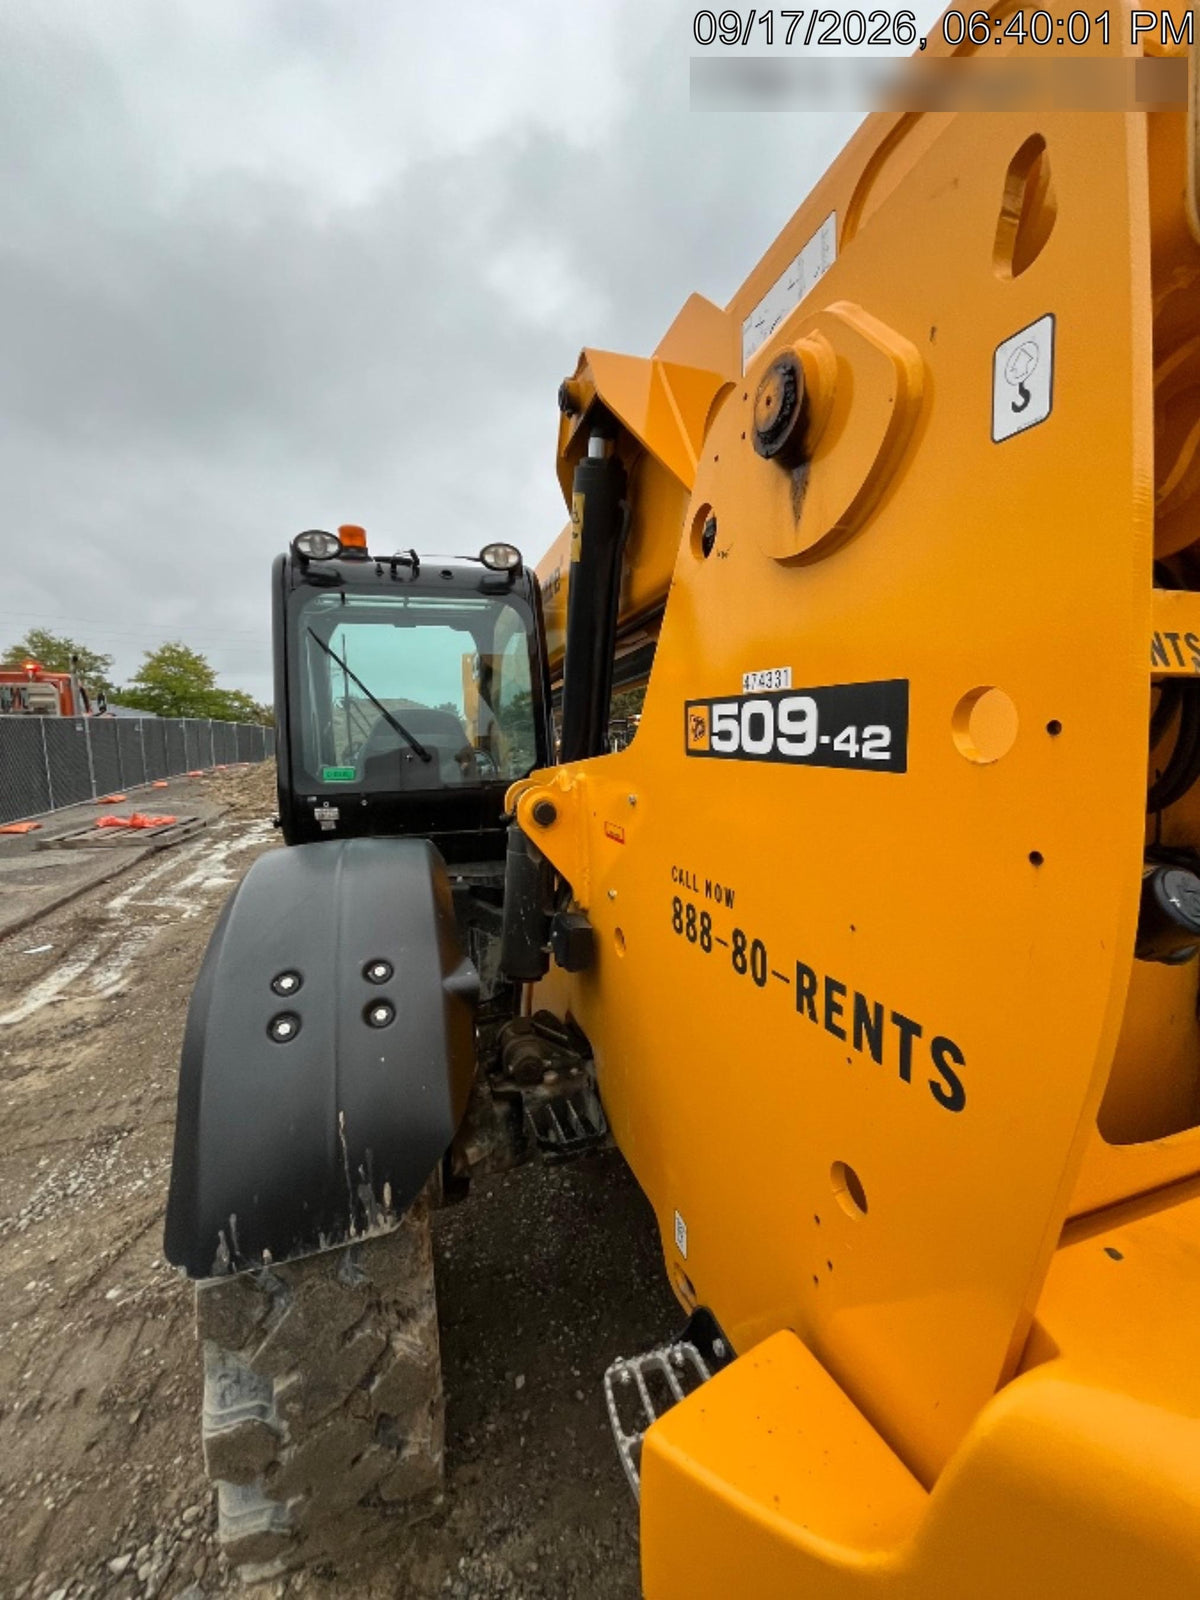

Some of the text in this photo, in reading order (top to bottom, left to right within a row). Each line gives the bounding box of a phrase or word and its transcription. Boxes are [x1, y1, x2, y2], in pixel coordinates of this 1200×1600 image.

[743, 669, 788, 690] 474331
[711, 696, 892, 760] 509-42
[671, 865, 735, 909] CALL NOW
[672, 896, 966, 1113] 888-80-RENTS
